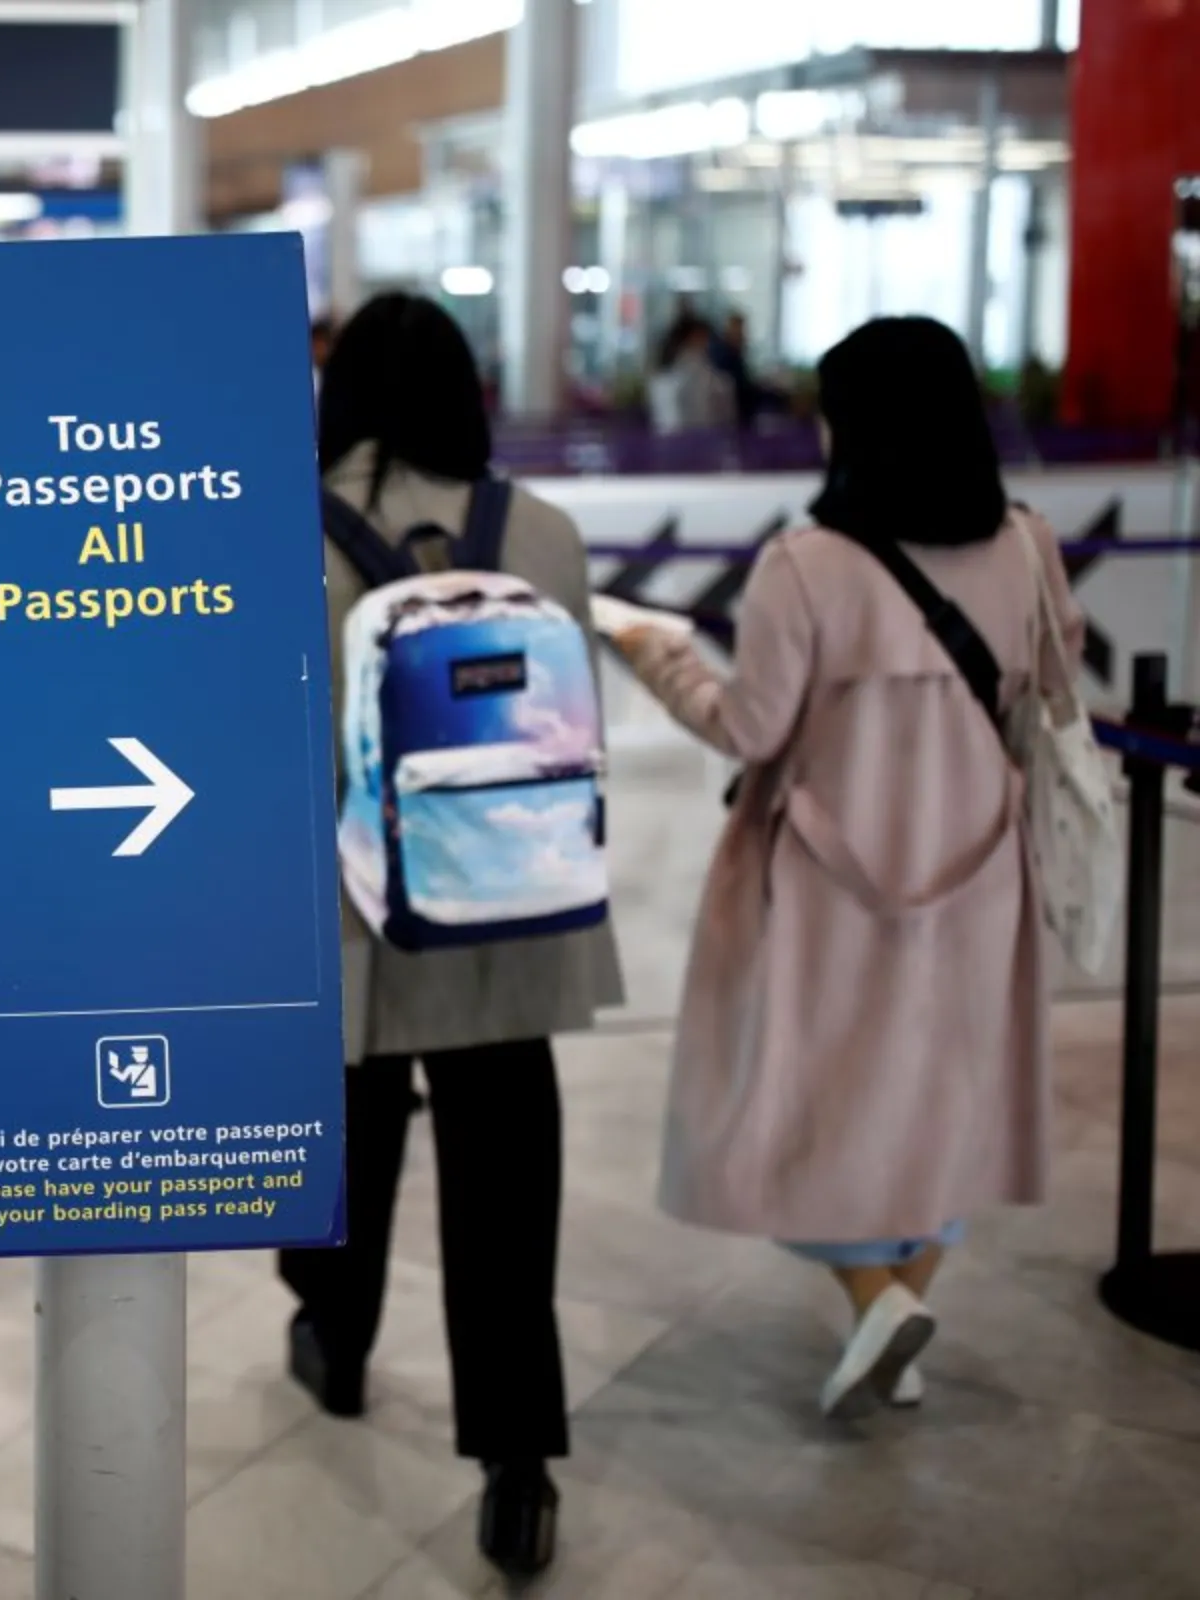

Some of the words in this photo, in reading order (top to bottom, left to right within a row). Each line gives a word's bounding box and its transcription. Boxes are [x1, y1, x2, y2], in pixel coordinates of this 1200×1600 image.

[48, 415, 161, 451] Tous
[79, 523, 144, 564] All
[13, 1129, 40, 1147] de
[48, 1128, 142, 1150] préparer
[150, 1126, 207, 1142] votre
[216, 1120, 322, 1144] passeport
[57, 1154, 112, 1171] carte
[120, 1147, 306, 1169] d'embarquement
[44, 1179, 95, 1196] have
[103, 1180, 152, 1199] your
[161, 1174, 255, 1196] passport
[262, 1170, 302, 1189] and
[53, 1202, 151, 1223] boarding
[160, 1203, 207, 1221] pass
[215, 1196, 276, 1217] ready
